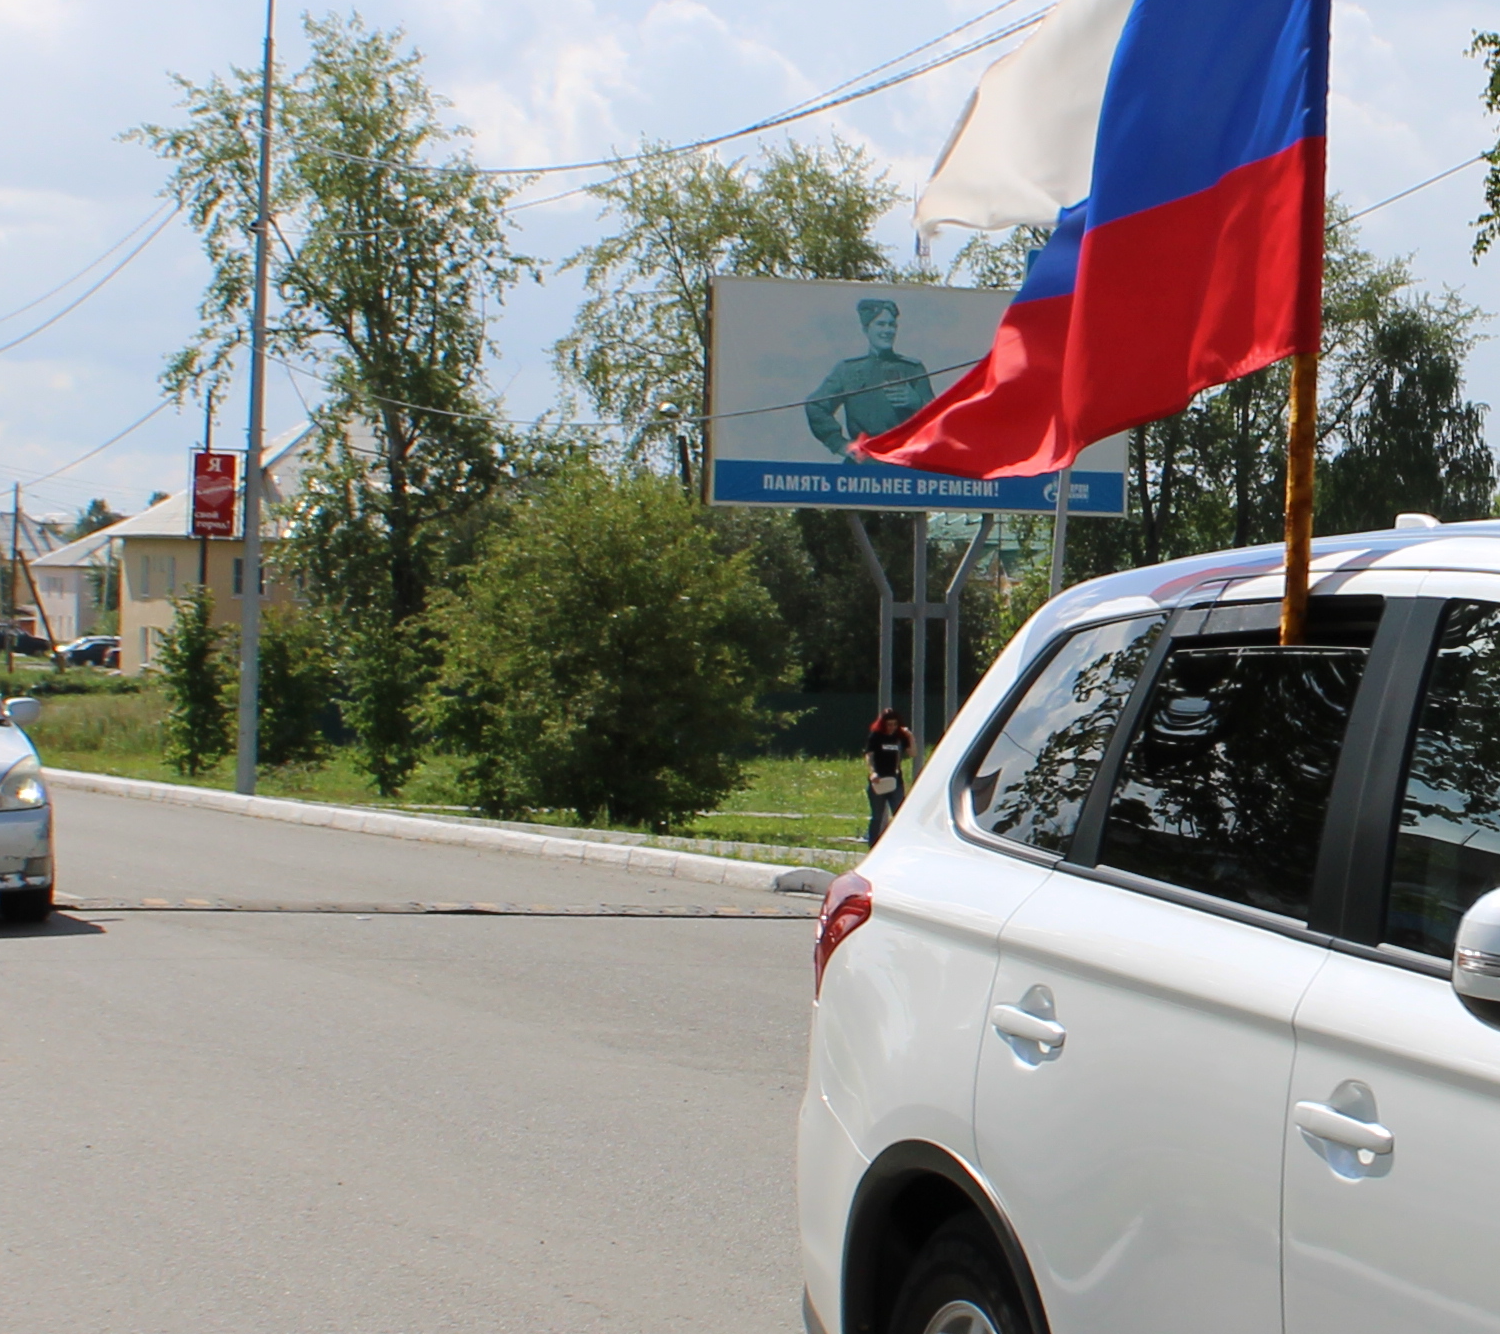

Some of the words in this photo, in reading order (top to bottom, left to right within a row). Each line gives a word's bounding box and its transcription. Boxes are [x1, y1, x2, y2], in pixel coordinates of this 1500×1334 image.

[206, 457, 222, 472] Я
[763, 473, 831, 492] ПАМЯТЬ
[837, 475, 912, 496] СИЛЬНЕЕ
[917, 479, 1000, 498] ВРЕМЕНИ!
